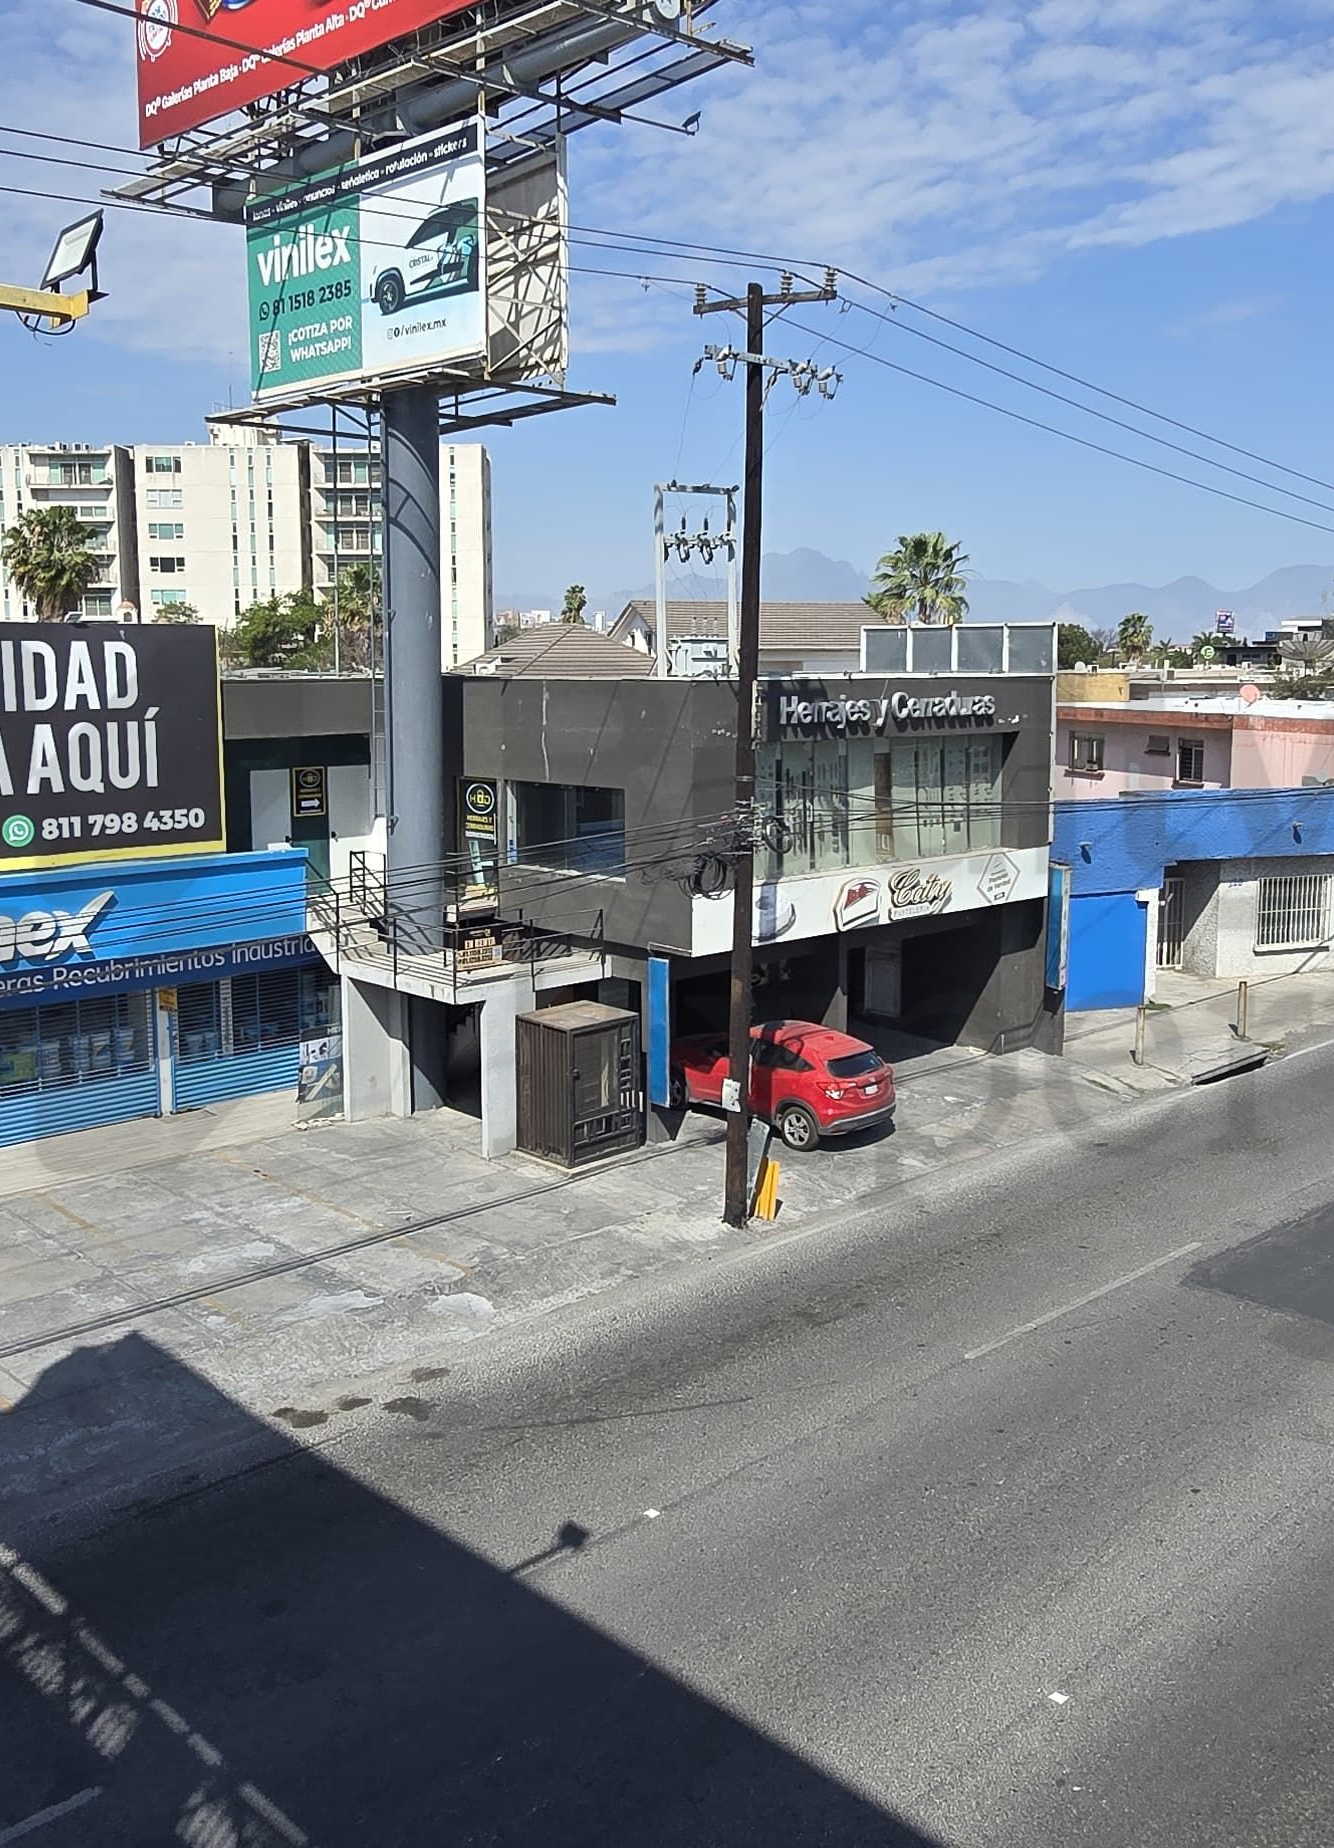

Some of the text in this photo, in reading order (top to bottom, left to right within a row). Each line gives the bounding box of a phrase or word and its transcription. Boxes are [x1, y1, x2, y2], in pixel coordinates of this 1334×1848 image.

[161, 84, 194, 110] Galerías
[191, 72, 219, 97] Planta
[218, 64, 240, 87] Baja
[293, 22, 326, 48] Planta
[324, 13, 346, 37] Alta
[257, 224, 352, 287] vinilex
[272, 278, 353, 318] 81 1518 2385
[287, 314, 354, 347] ¡COTIZA POR
[779, 690, 996, 729] Herrajes y Cerraduras
[25, 706, 161, 796] AQUÍ
[40, 807, 207, 842] 811 798 4350
[52, 948, 226, 991] Recubrimientos
